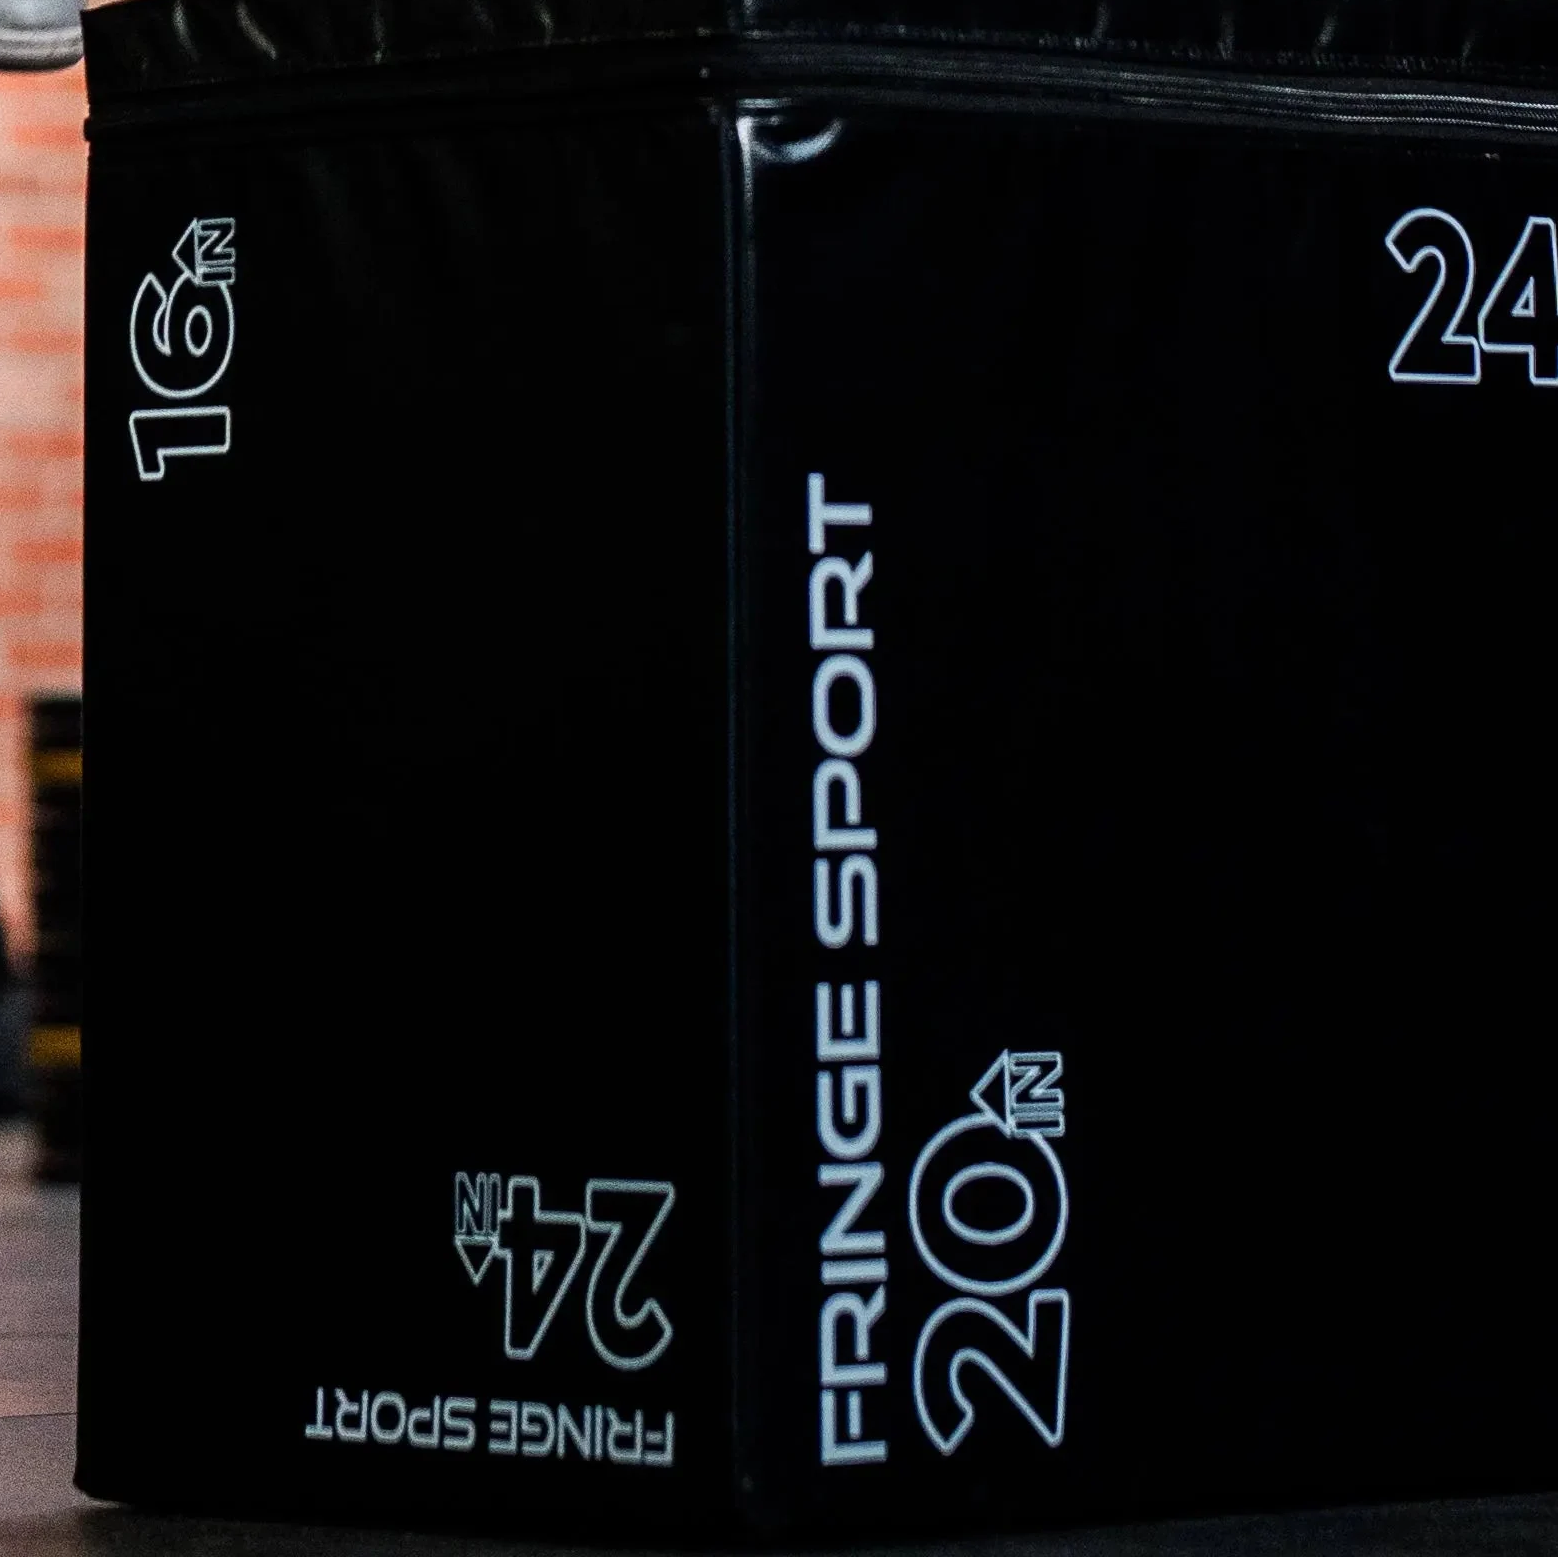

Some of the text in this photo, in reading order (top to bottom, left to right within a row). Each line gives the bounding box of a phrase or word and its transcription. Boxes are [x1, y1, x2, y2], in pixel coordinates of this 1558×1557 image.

[807, 473, 889, 1467] FRINGE SPORT
[304, 1386, 675, 1467] FRINGE SPORT
